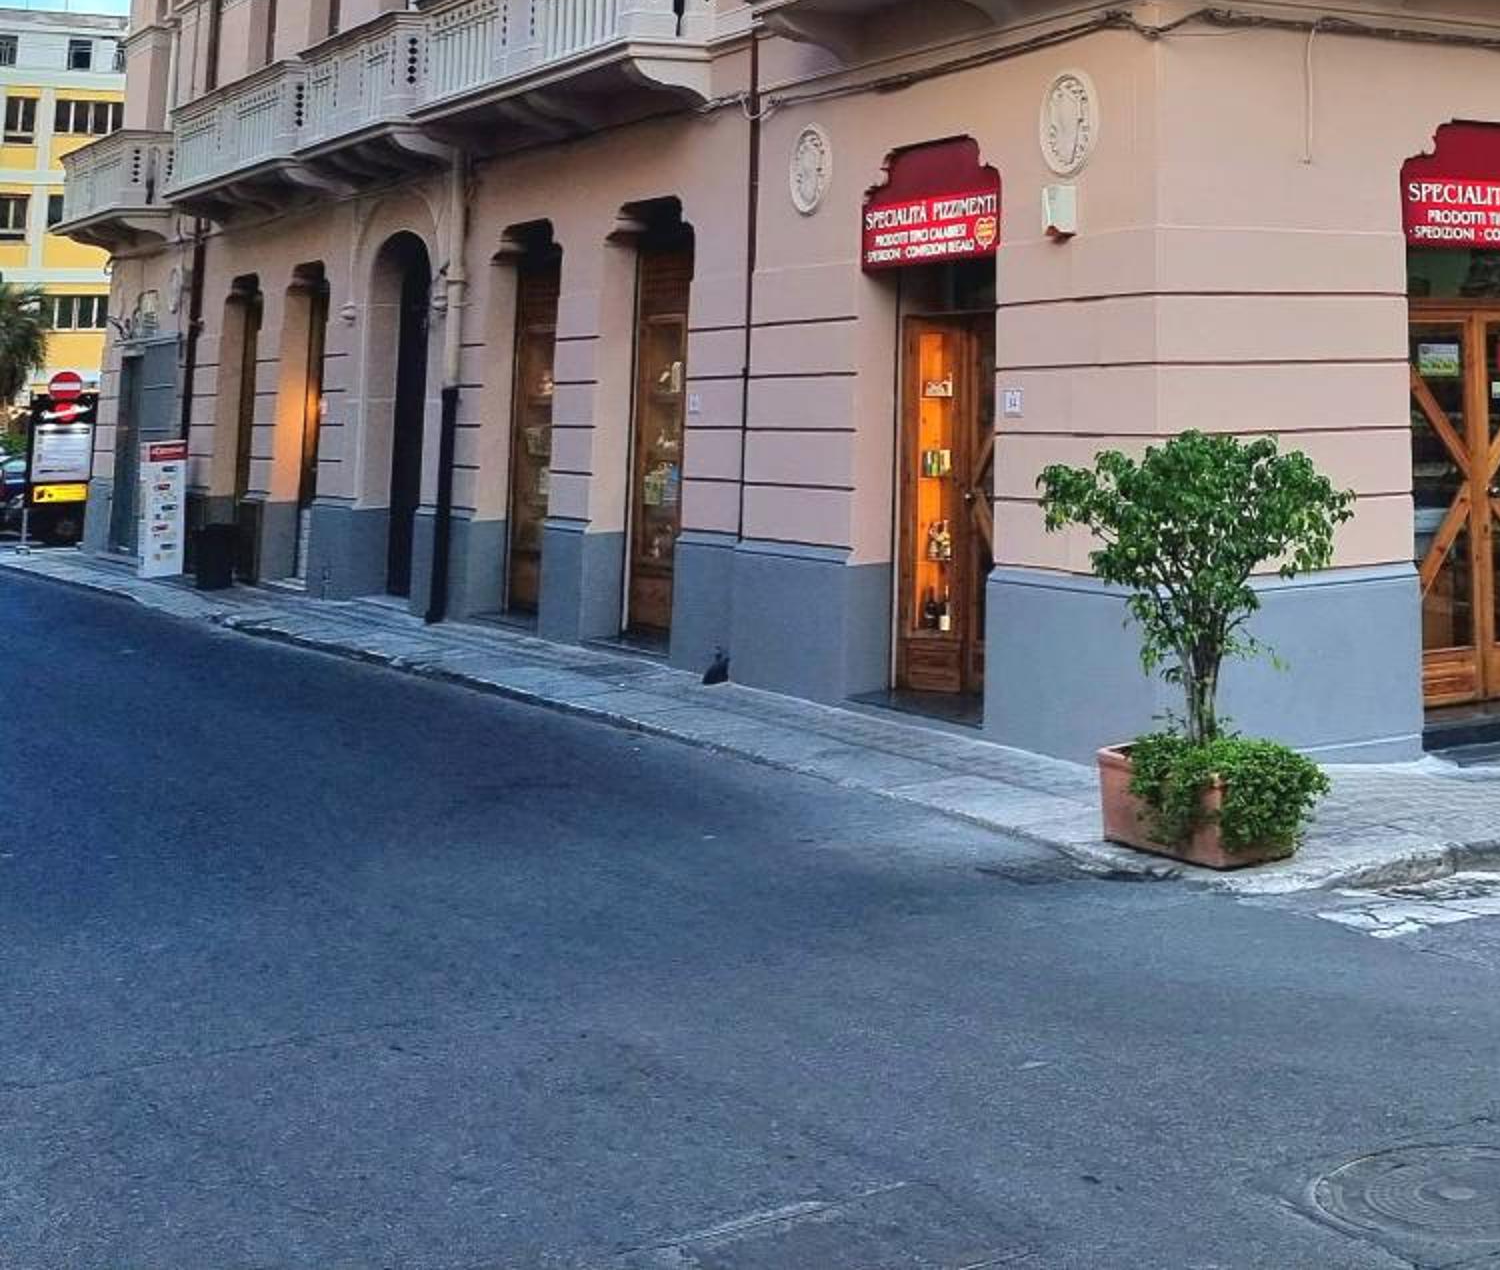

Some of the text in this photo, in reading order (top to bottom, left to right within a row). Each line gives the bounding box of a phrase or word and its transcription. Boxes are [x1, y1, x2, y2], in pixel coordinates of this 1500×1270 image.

[865, 194, 997, 230] SPECIALITÀ PIZZIMENTI
[1427, 209, 1487, 225] PRODOTTI
[1414, 225, 1475, 241] SPEDIZIONI
